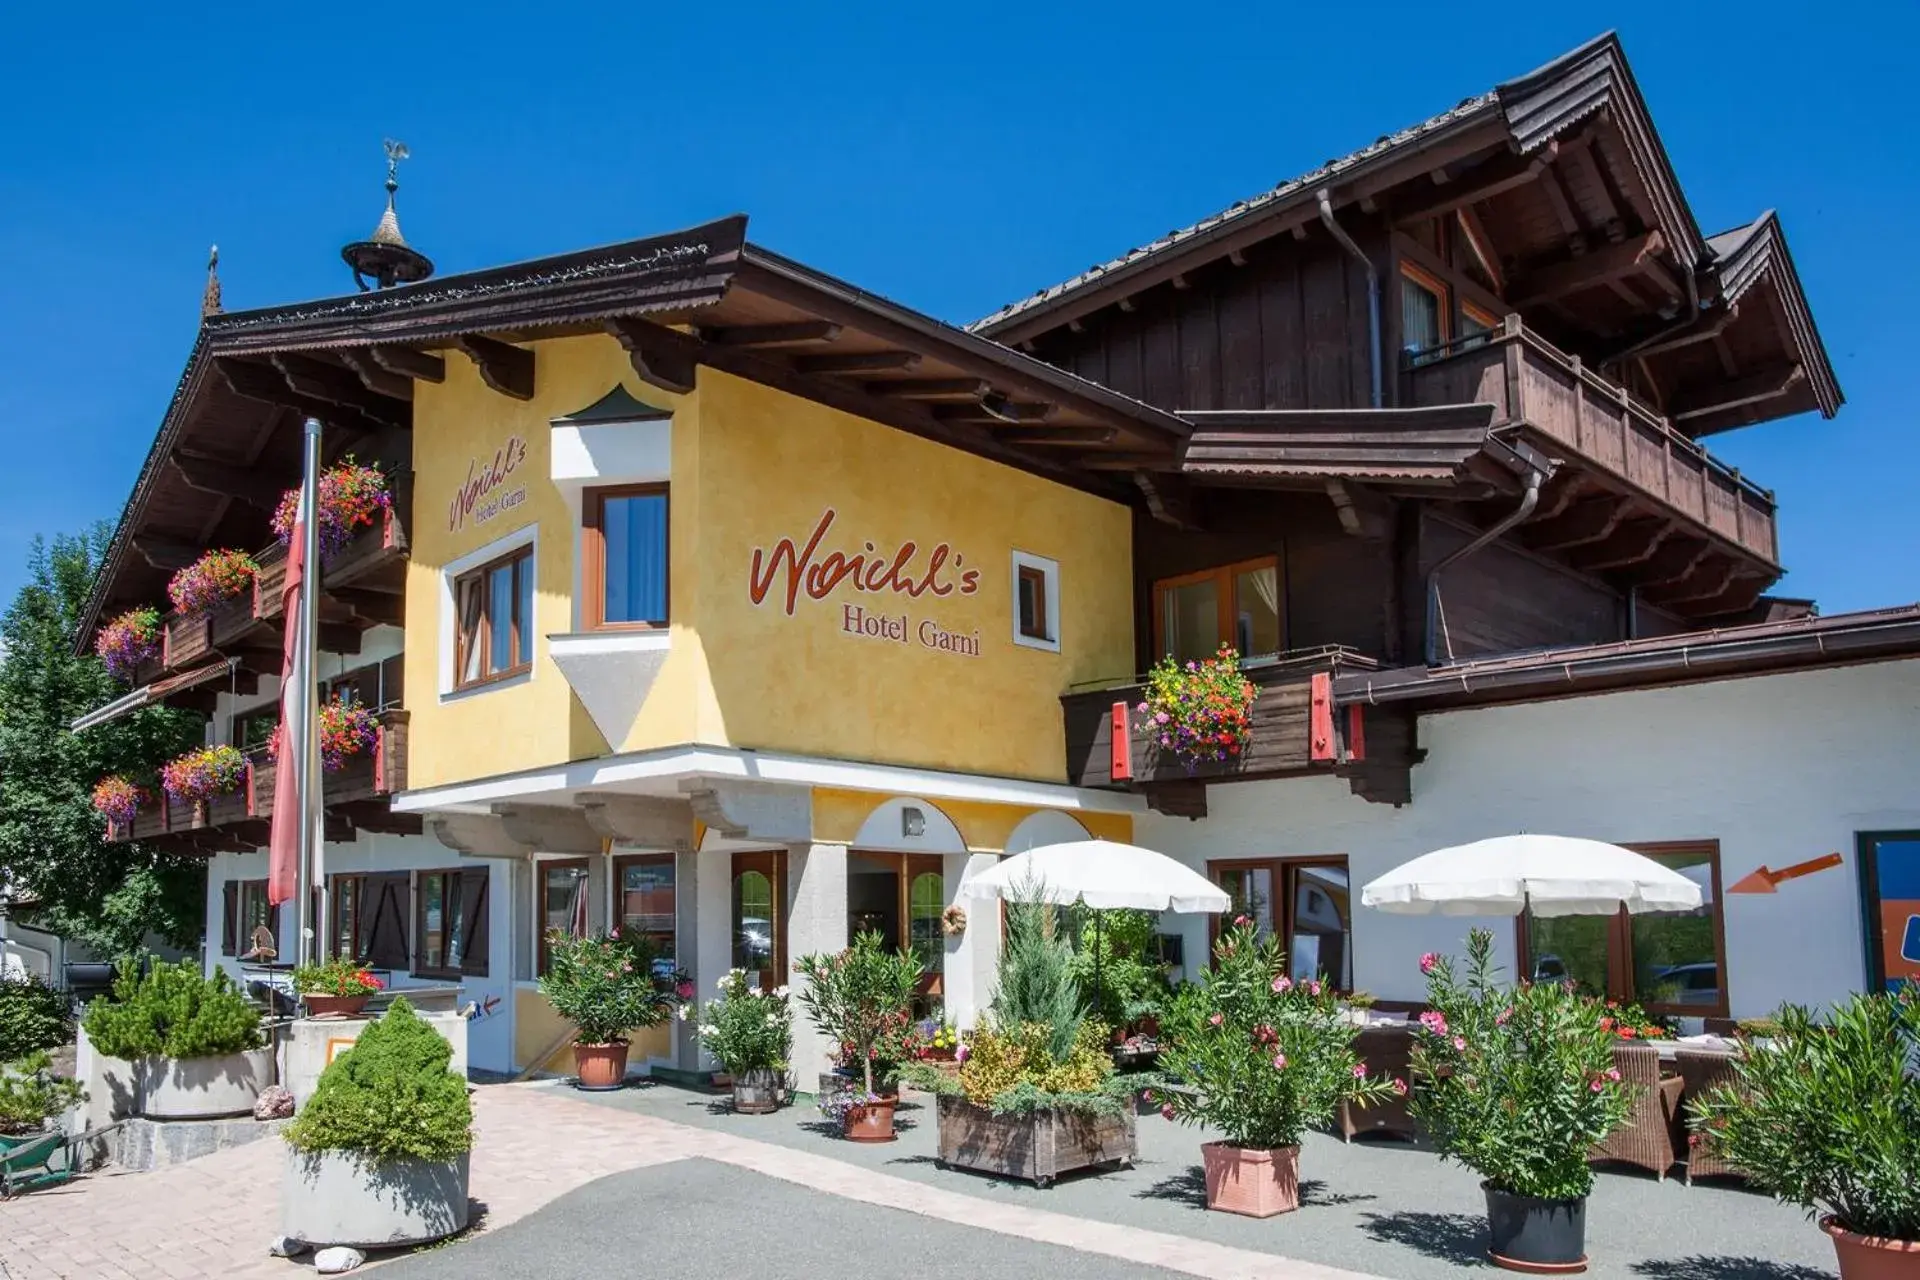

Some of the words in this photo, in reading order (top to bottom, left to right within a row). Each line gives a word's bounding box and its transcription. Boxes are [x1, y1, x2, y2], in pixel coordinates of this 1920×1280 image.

[476, 498, 499, 524] Hotel
[501, 482, 526, 510] Garni
[842, 604, 909, 643] Hotel
[918, 620, 981, 656] Garni
